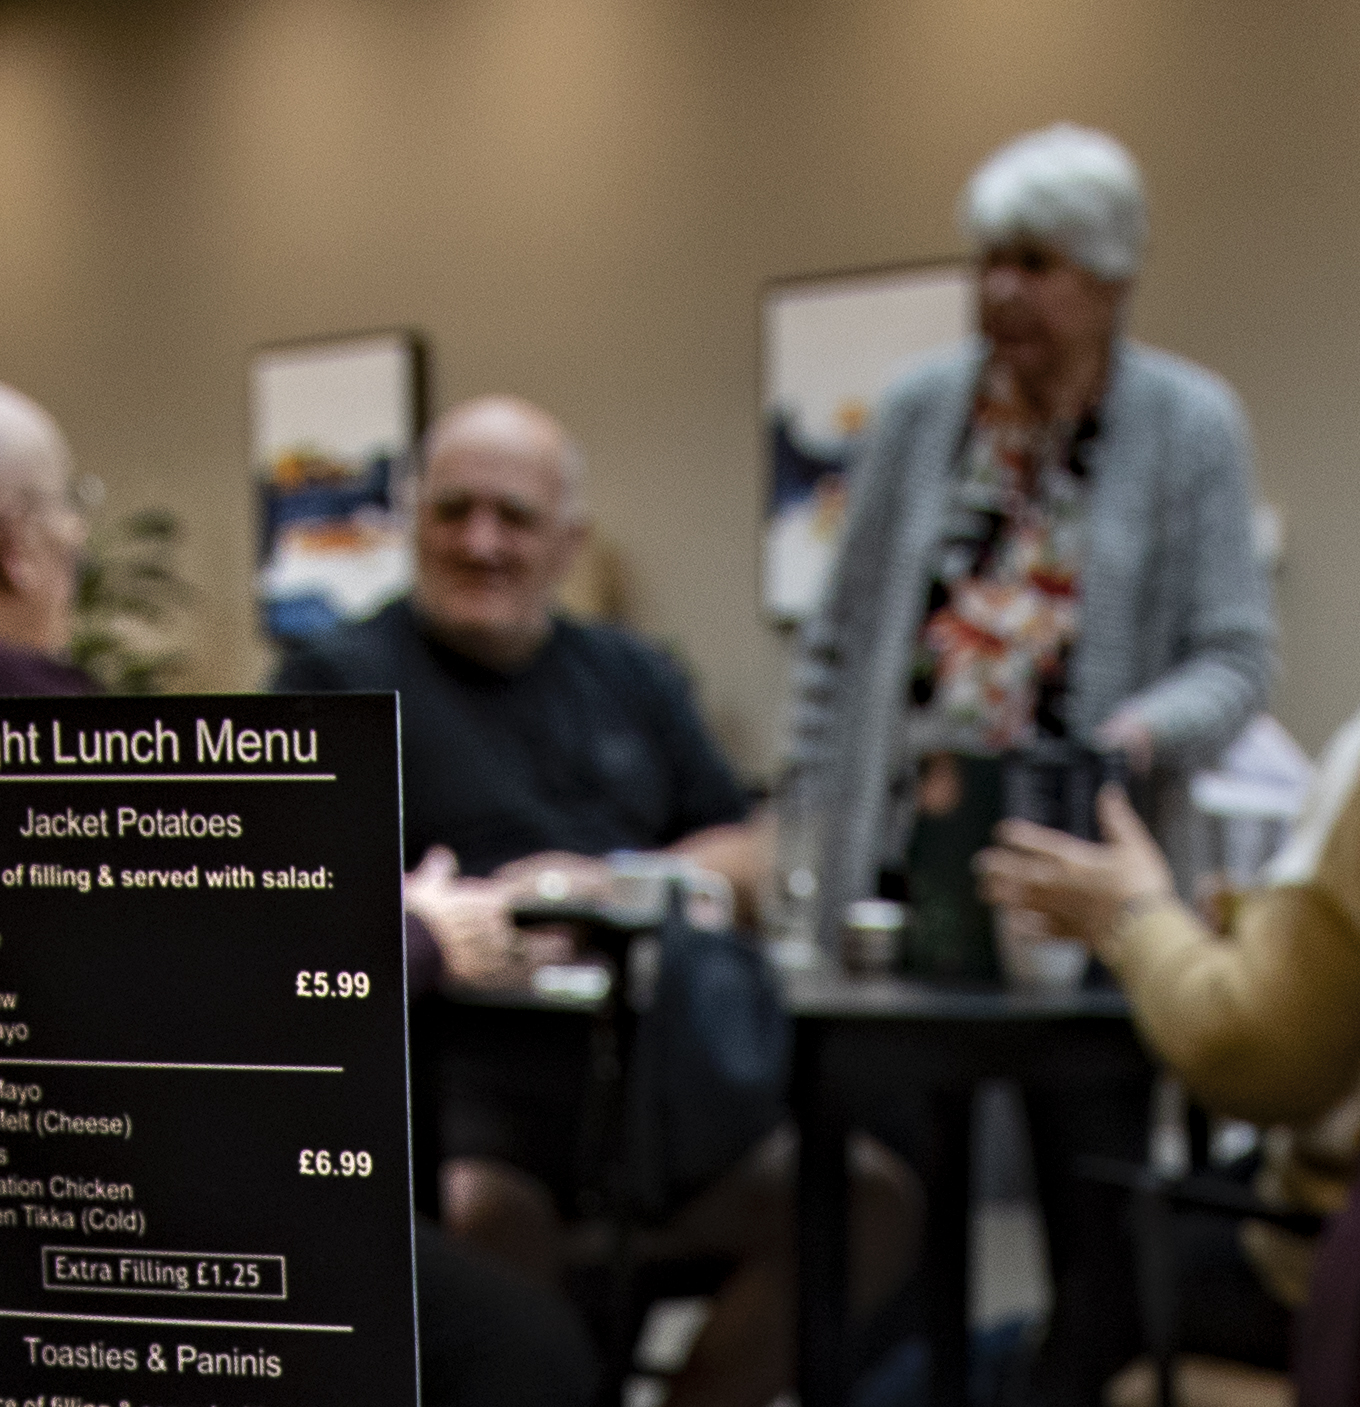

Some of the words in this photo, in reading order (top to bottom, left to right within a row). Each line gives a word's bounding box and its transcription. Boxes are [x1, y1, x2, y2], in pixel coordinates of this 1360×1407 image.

[52, 719, 180, 764] Lunch
[195, 718, 318, 763] Menu
[19, 807, 109, 838] Jacket
[117, 806, 243, 838] Potatoes
[1, 863, 24, 887] of
[28, 863, 92, 893] filling
[97, 864, 114, 888] &
[120, 865, 199, 888] served
[205, 865, 255, 889] with
[261, 865, 334, 889] salad:
[295, 970, 371, 999] £5.99
[36, 1110, 133, 1139] (Cheese)
[298, 1148, 373, 1178] £6.99
[49, 1175, 134, 1200] Chicken
[24, 1205, 76, 1228] Tikka
[81, 1208, 146, 1235] (Cold)
[54, 1255, 112, 1281] Extra
[119, 1258, 190, 1290] Filling
[197, 1261, 260, 1288] £1.25
[23, 1335, 139, 1372] Toasties
[146, 1343, 167, 1372] &
[176, 1344, 283, 1378] Paninis
